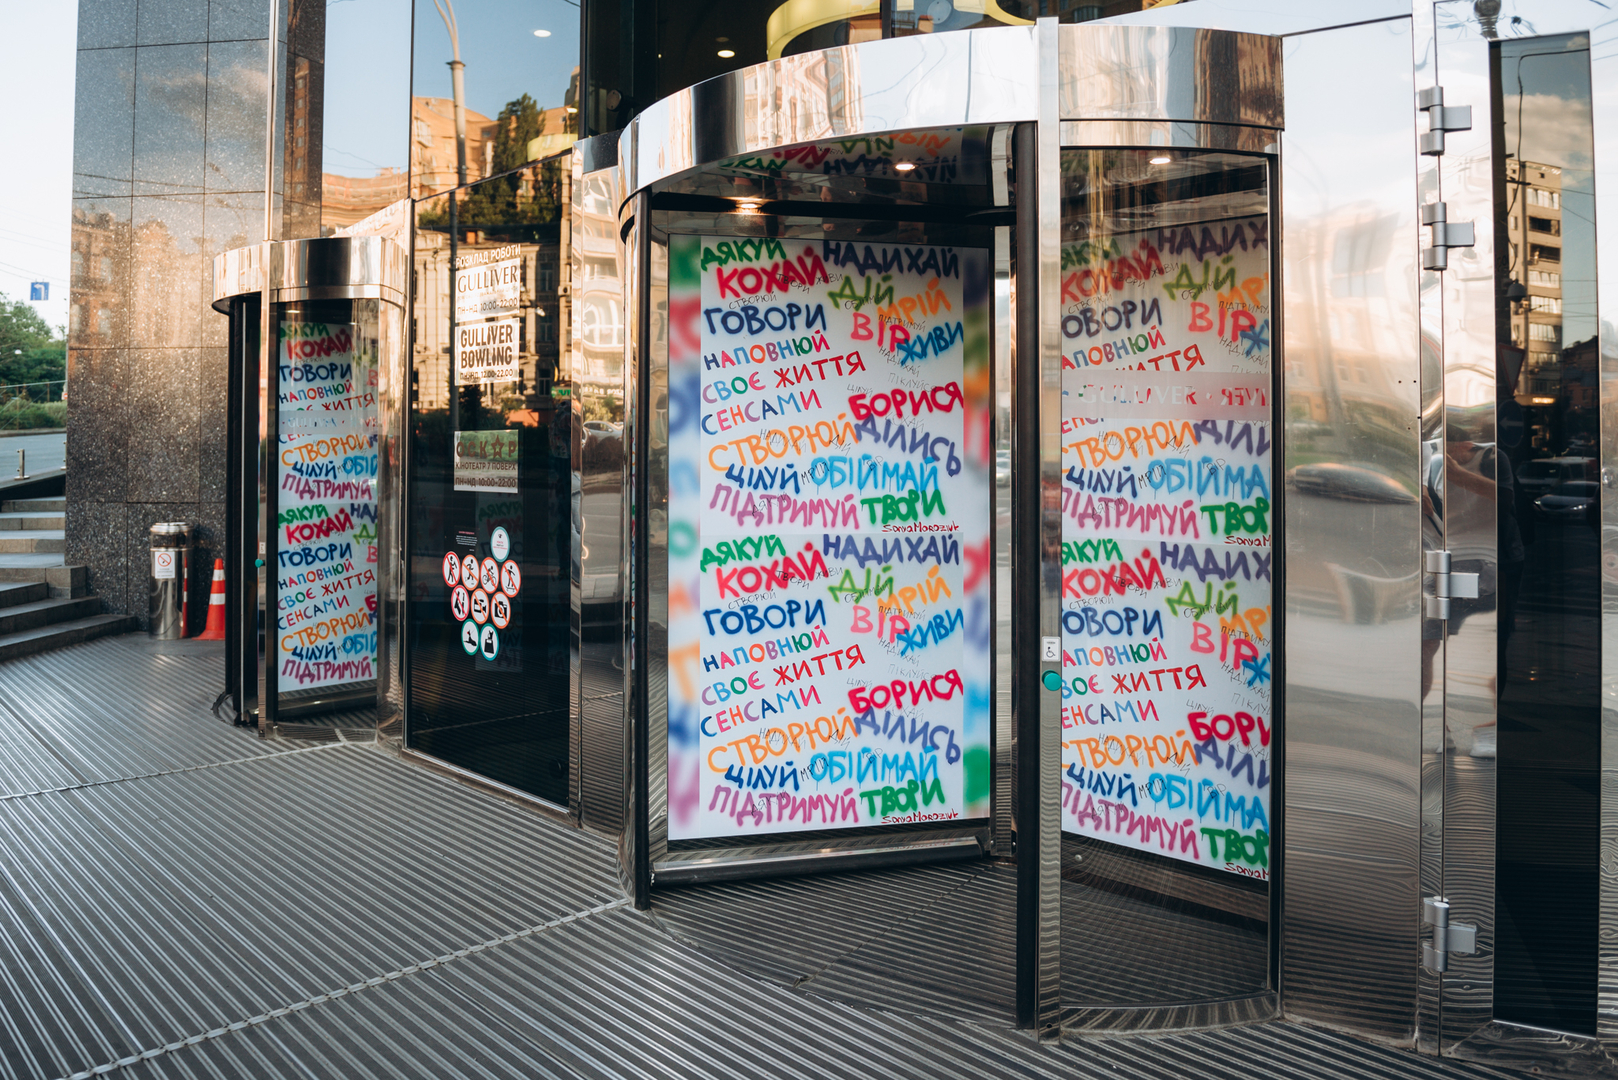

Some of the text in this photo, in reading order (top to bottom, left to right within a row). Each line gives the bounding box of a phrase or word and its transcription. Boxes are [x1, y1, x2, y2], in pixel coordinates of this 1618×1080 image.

[456, 244, 521, 268] РОЗКЛАД РОБОТИ
[700, 238, 786, 271] ДЯКУЙ
[717, 246, 829, 299] КОХАЙ
[823, 239, 959, 279] НАДИХАЙ
[458, 265, 518, 293] GULLIVER
[828, 274, 894, 311] ДІЙ
[1162, 255, 1236, 301] ДІЙ
[480, 297, 518, 312] 10:00-22:00
[704, 303, 827, 335] ГОВОРИ
[877, 277, 952, 326] МРІЙ
[1061, 298, 1162, 339] ОВОРИ
[460, 324, 513, 349] GULLIVER
[851, 312, 910, 353] ВІР
[1188, 302, 1257, 342] ВІР
[286, 327, 354, 361] КОХАЙ
[461, 346, 513, 369] BOWLING
[704, 329, 830, 370] НАПОВНЮЙ
[896, 321, 964, 366] ЖИВИ
[278, 379, 355, 404] НАПОВНЮЙ
[279, 362, 353, 383] ГОВОРИ
[702, 351, 866, 404] СВОЄ ЖИТТЯ
[702, 388, 822, 436] СЕНСАМИ
[848, 381, 964, 421] БОРИСЯ
[1078, 384, 1198, 405] GULLIVER
[281, 433, 372, 466] СТВОРЮЙ
[709, 412, 860, 472] СТВОРЮЙ
[855, 413, 961, 477] ДІЛИСЬ
[1062, 419, 1198, 473] ТВОРЮЙ
[292, 461, 338, 480] ЦІЛУЙ
[456, 462, 486, 470] КІНОТЕАТР
[492, 462, 516, 470] ПОВЕРХ
[725, 463, 800, 494] ЦІЛУЙ
[810, 453, 938, 493] ОБІЙМАЙ
[1066, 465, 1138, 499] ЦІЛУЙ
[282, 473, 372, 500] ПІДТРИМУЙ
[285, 507, 354, 545] КОХАЙ
[710, 484, 860, 530] ПІДТРИМУЙ
[860, 489, 946, 525] ТВОРИ
[278, 542, 353, 568] ГОВОРИ
[700, 534, 786, 572] ДЯКУЙ
[716, 542, 829, 600] КОХАЙ
[823, 534, 960, 569] НАДИХАЙ
[278, 558, 355, 590] НАПОВНЮЙ
[278, 569, 375, 610] СВОЄ ЖИТТЯ
[828, 565, 894, 604] ДІЙ
[877, 564, 952, 620] МРІЙ
[1062, 549, 1166, 599] КОХАЙ
[278, 595, 350, 630] СЕНСАМИ
[703, 599, 827, 636] ГОВОРИ
[1165, 581, 1239, 621] ДІЙ
[281, 607, 372, 653] СТВОРЮЙ
[850, 605, 910, 644] ВІР
[896, 608, 964, 657] ЖИВИ
[1062, 607, 1164, 639] ОВОРИ
[291, 641, 337, 661] ЦІЛУЙ
[703, 625, 830, 673] НАПОВНЮЙ
[1189, 621, 1259, 671] ВІР
[282, 656, 372, 684] ПІДТРИМУЙ
[701, 644, 866, 705] СВОЄ ЖИТТЯ
[1111, 663, 1207, 695] ЖИТТЯ
[701, 685, 822, 737] СЕНСАМИ
[848, 669, 964, 714] БОРИСЯ
[708, 707, 859, 773] СТВОРЮЙ
[854, 706, 961, 765] ДІЛИСЬ
[725, 761, 800, 791] ЦІЛУЙ
[810, 746, 938, 787] ОБІЙМАЙ
[1067, 762, 1138, 807] ЦІЛУЙ
[709, 785, 860, 826] ПІДТРИМУЙ
[859, 777, 946, 817] ТВОРИ
